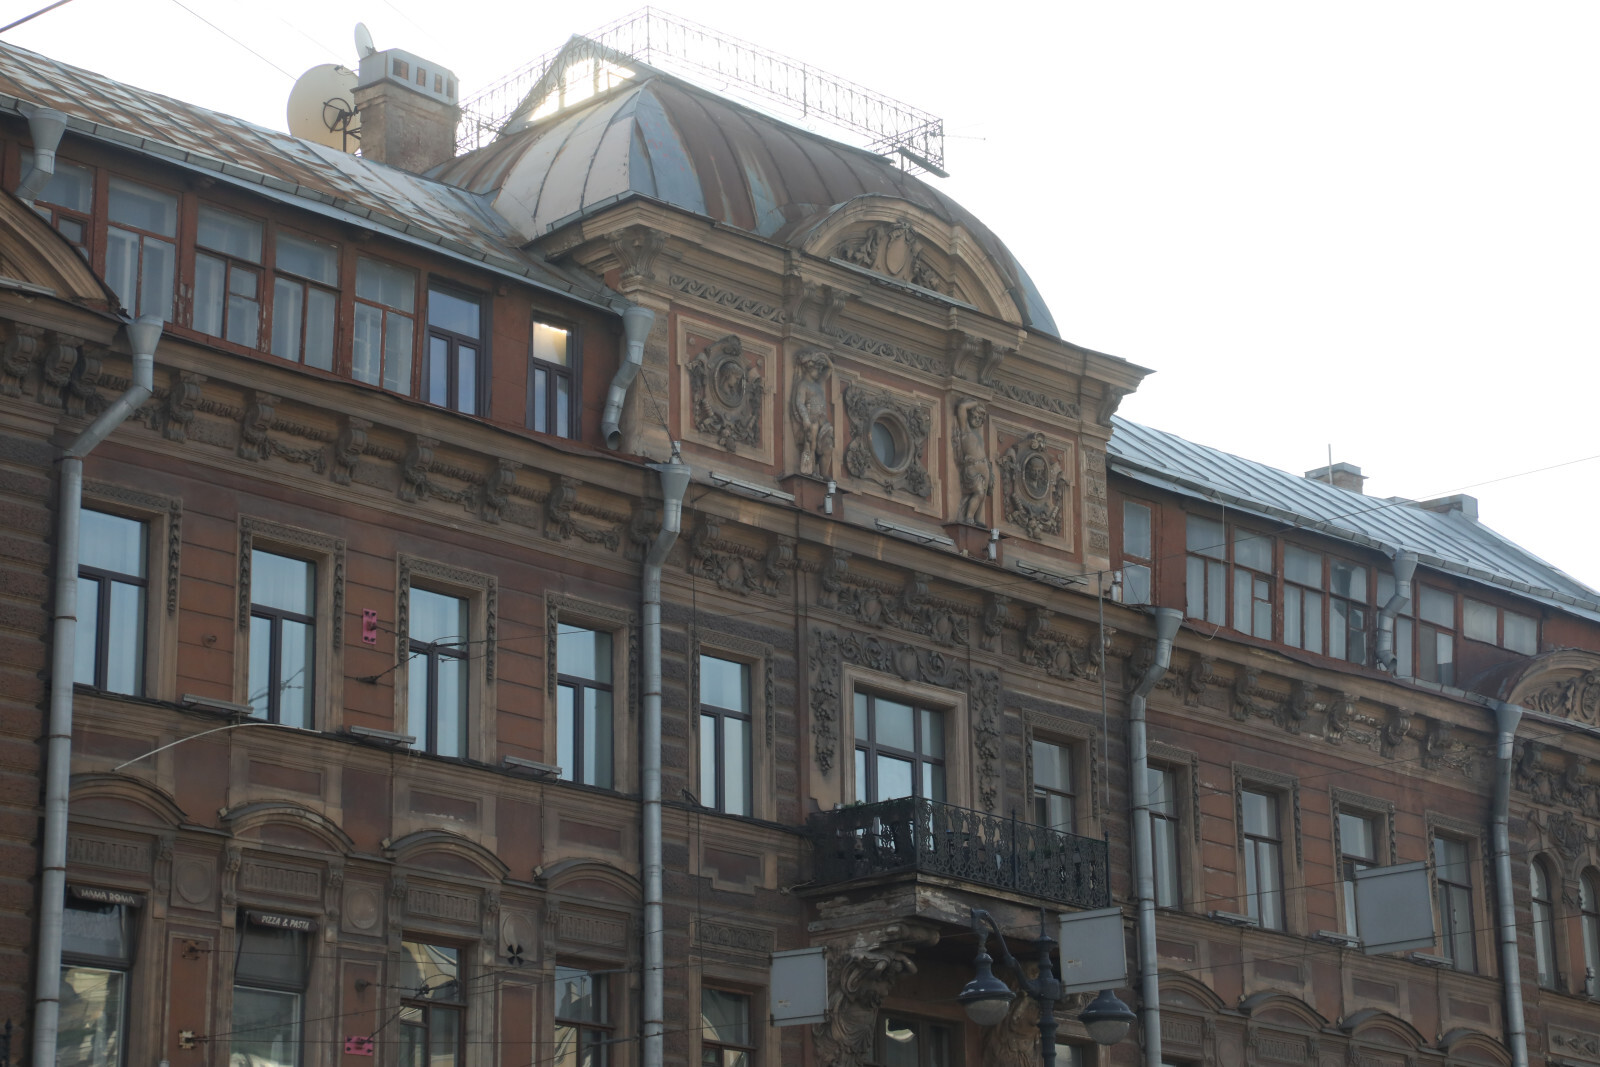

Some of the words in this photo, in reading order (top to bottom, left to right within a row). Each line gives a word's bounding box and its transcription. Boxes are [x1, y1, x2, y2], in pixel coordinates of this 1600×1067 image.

[81, 889, 107, 901] MAMA
[109, 892, 135, 904] ROMA
[261, 915, 281, 926] PIZZA
[282, 918, 288, 927] &
[290, 919, 310, 931] PASTA
